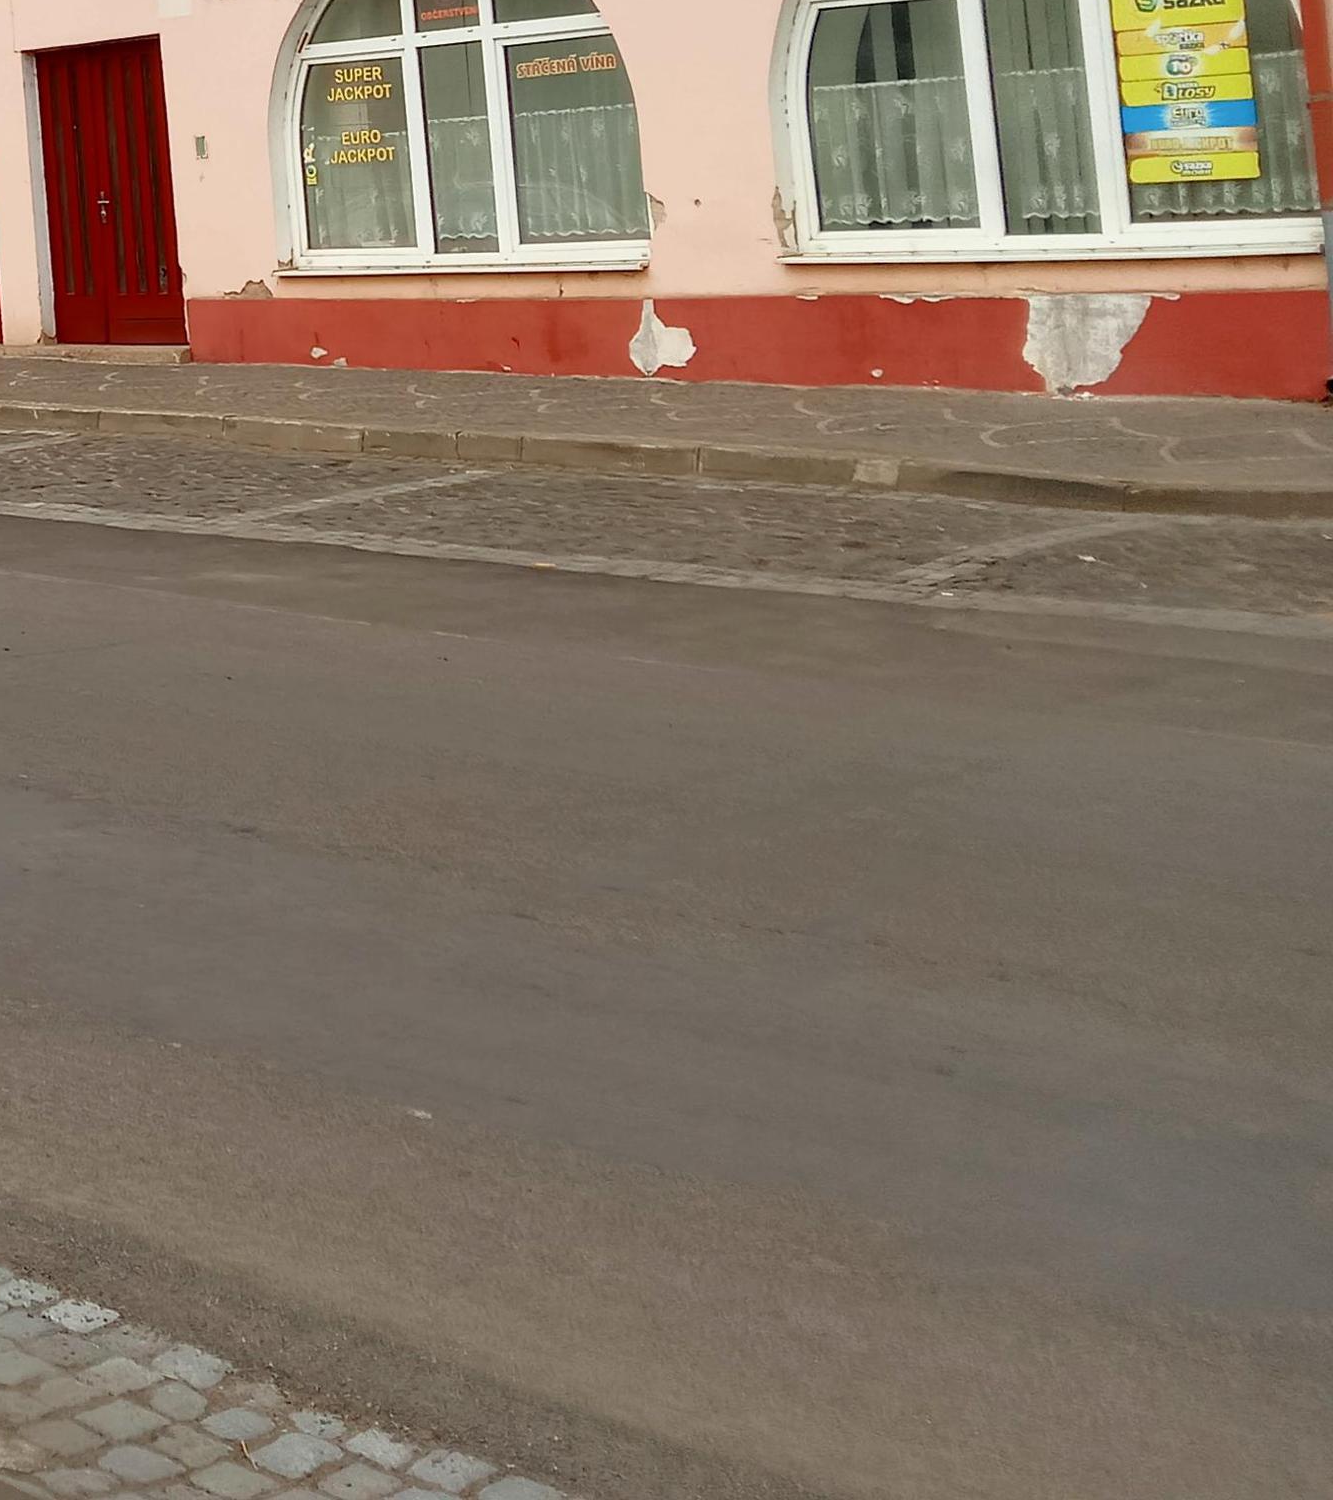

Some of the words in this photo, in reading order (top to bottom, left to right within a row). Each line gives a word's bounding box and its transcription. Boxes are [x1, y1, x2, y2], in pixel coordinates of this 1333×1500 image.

[579, 51, 616, 71] VÍNA
[334, 66, 382, 83] SUPER
[326, 84, 392, 101] JACKPOT
[341, 129, 382, 145] EURO
[330, 146, 395, 164] JACKPOT
